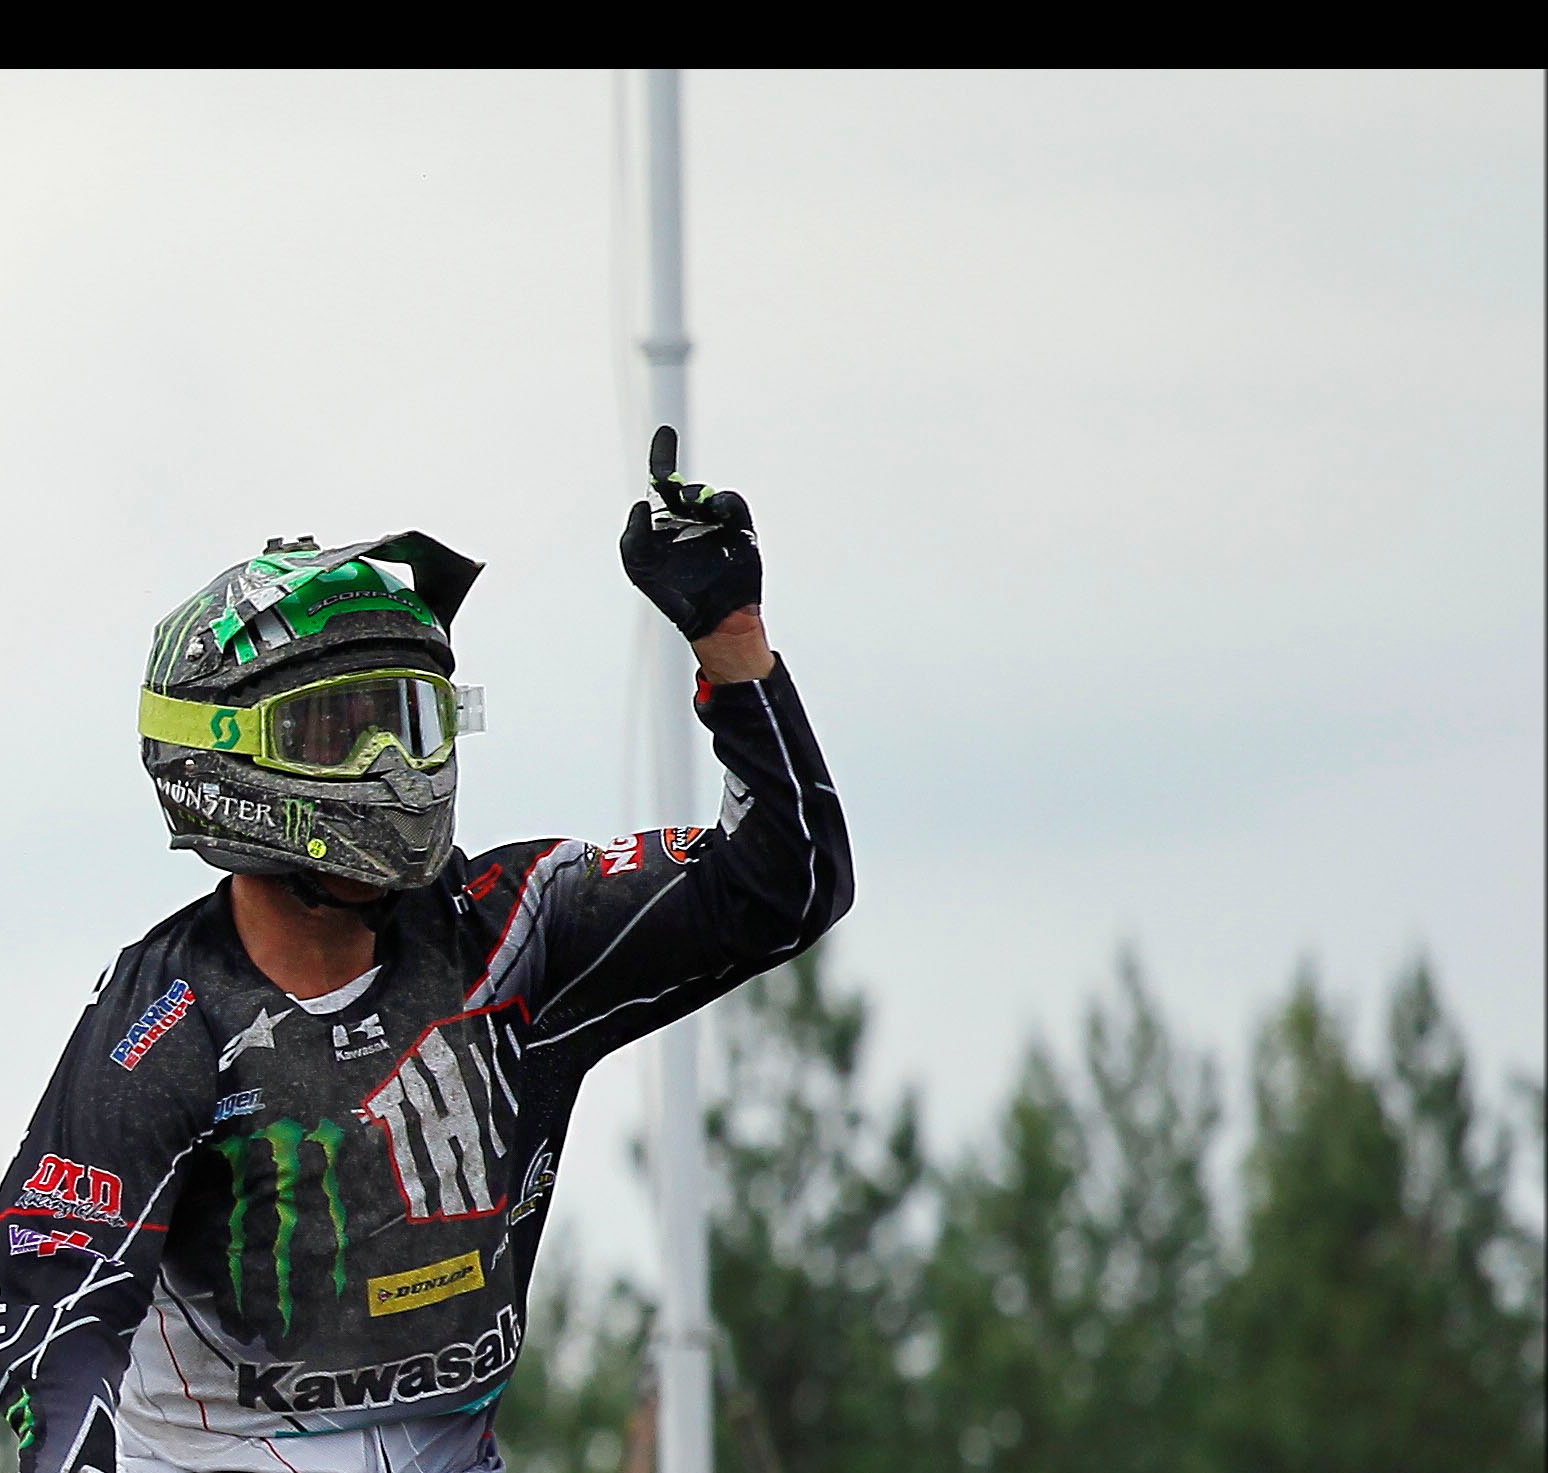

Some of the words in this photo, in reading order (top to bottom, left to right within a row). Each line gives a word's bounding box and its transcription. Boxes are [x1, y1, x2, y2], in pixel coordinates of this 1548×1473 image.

[110, 979, 189, 1063] PARTS
[335, 1038, 391, 1062] Kawasak
[23, 1153, 124, 1219] DID
[394, 1265, 475, 1299] DUNLOP
